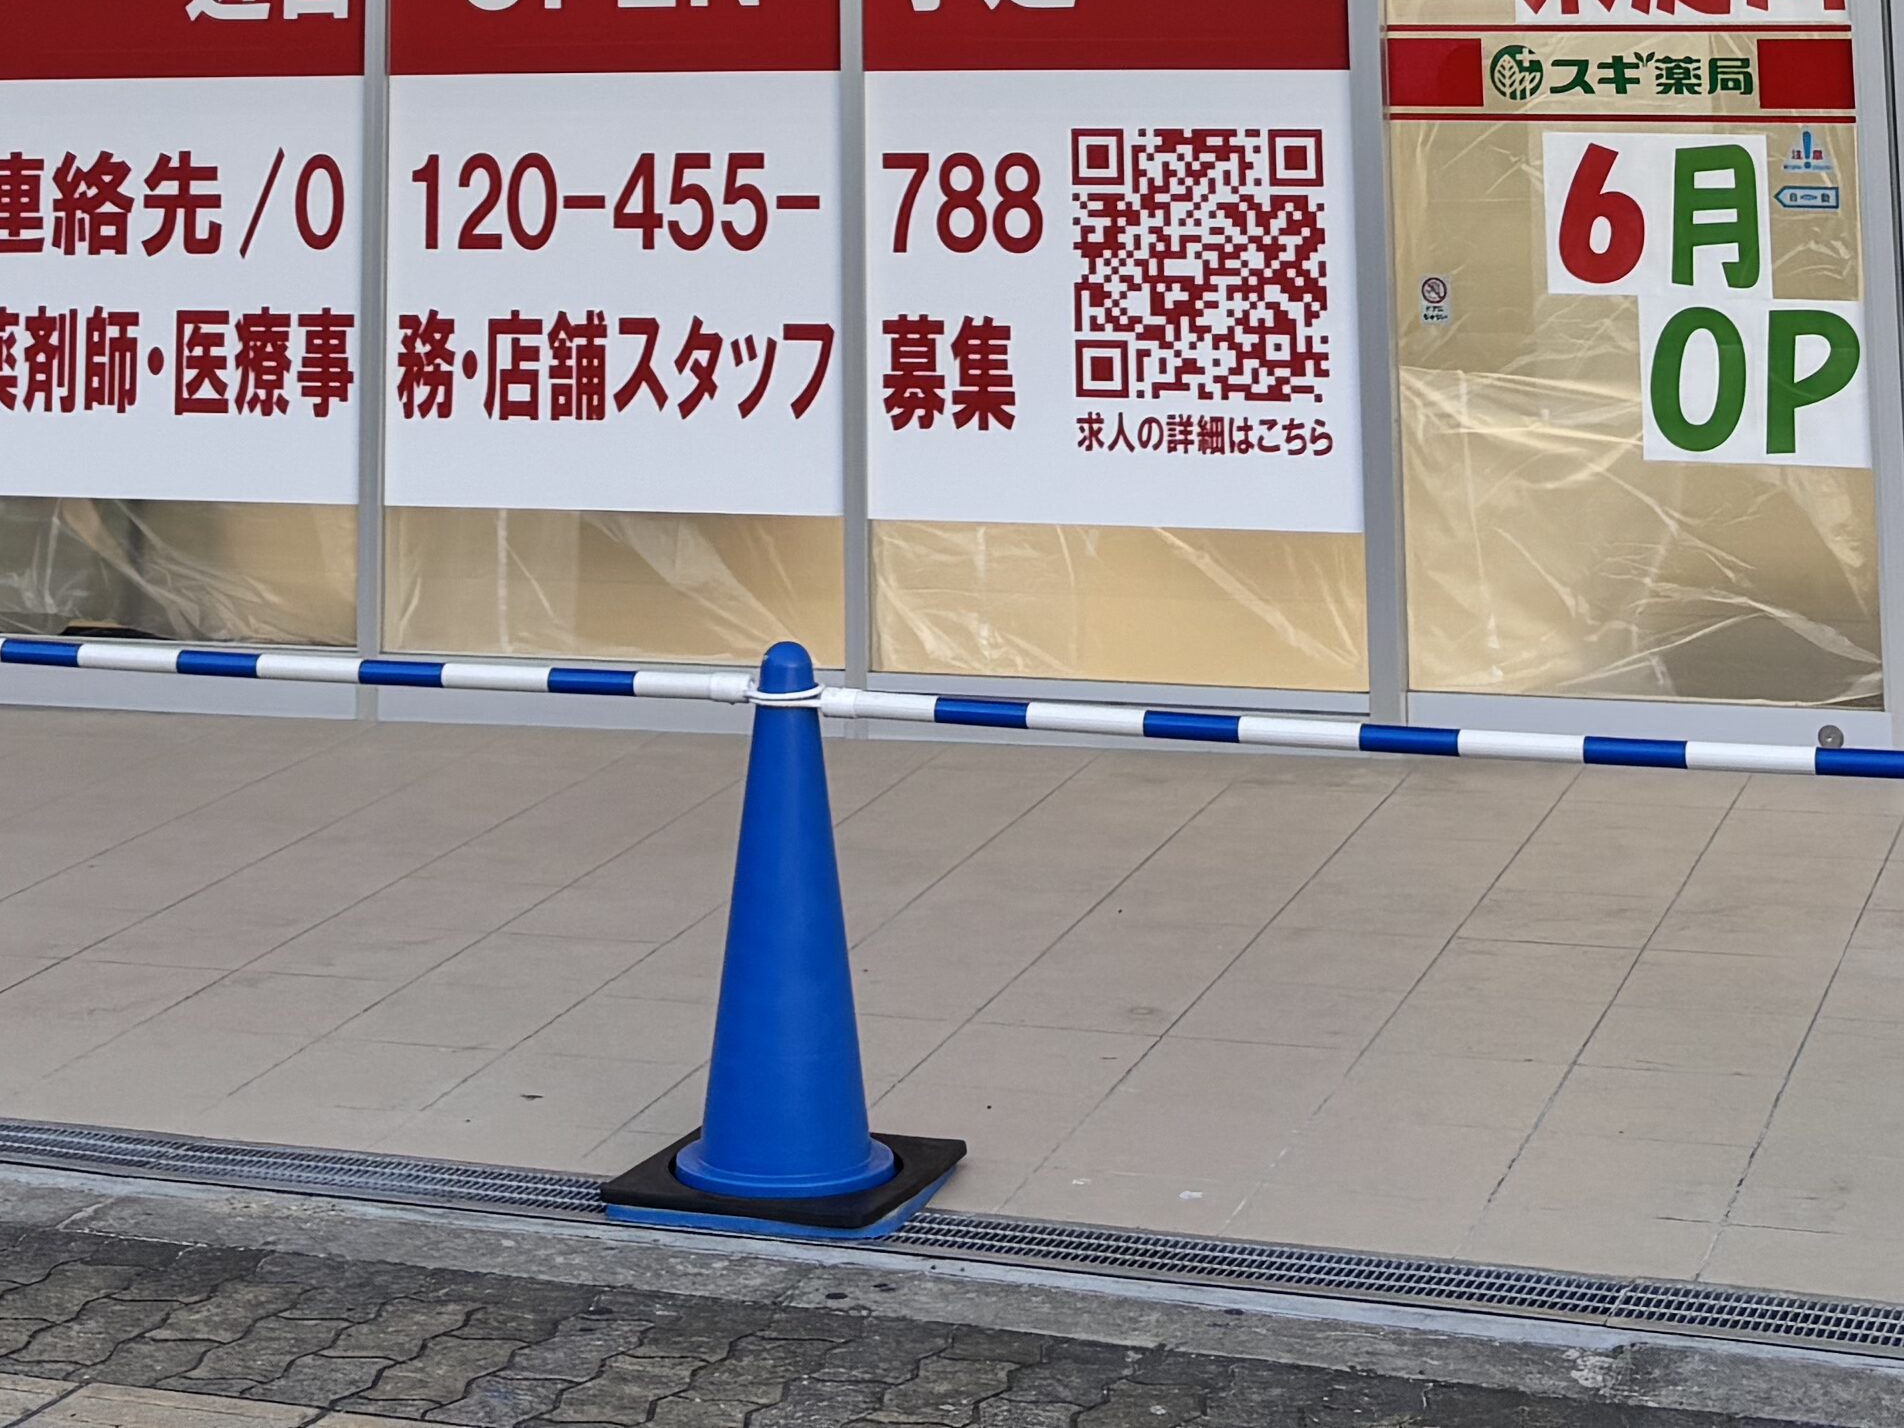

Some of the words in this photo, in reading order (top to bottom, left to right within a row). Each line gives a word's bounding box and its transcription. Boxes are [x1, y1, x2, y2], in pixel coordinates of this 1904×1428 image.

[1549, 51, 1754, 95] スギ薬局
[1559, 144, 1760, 288] 6月
[1075, 412, 1333, 457] 求人の詳細はこちら
